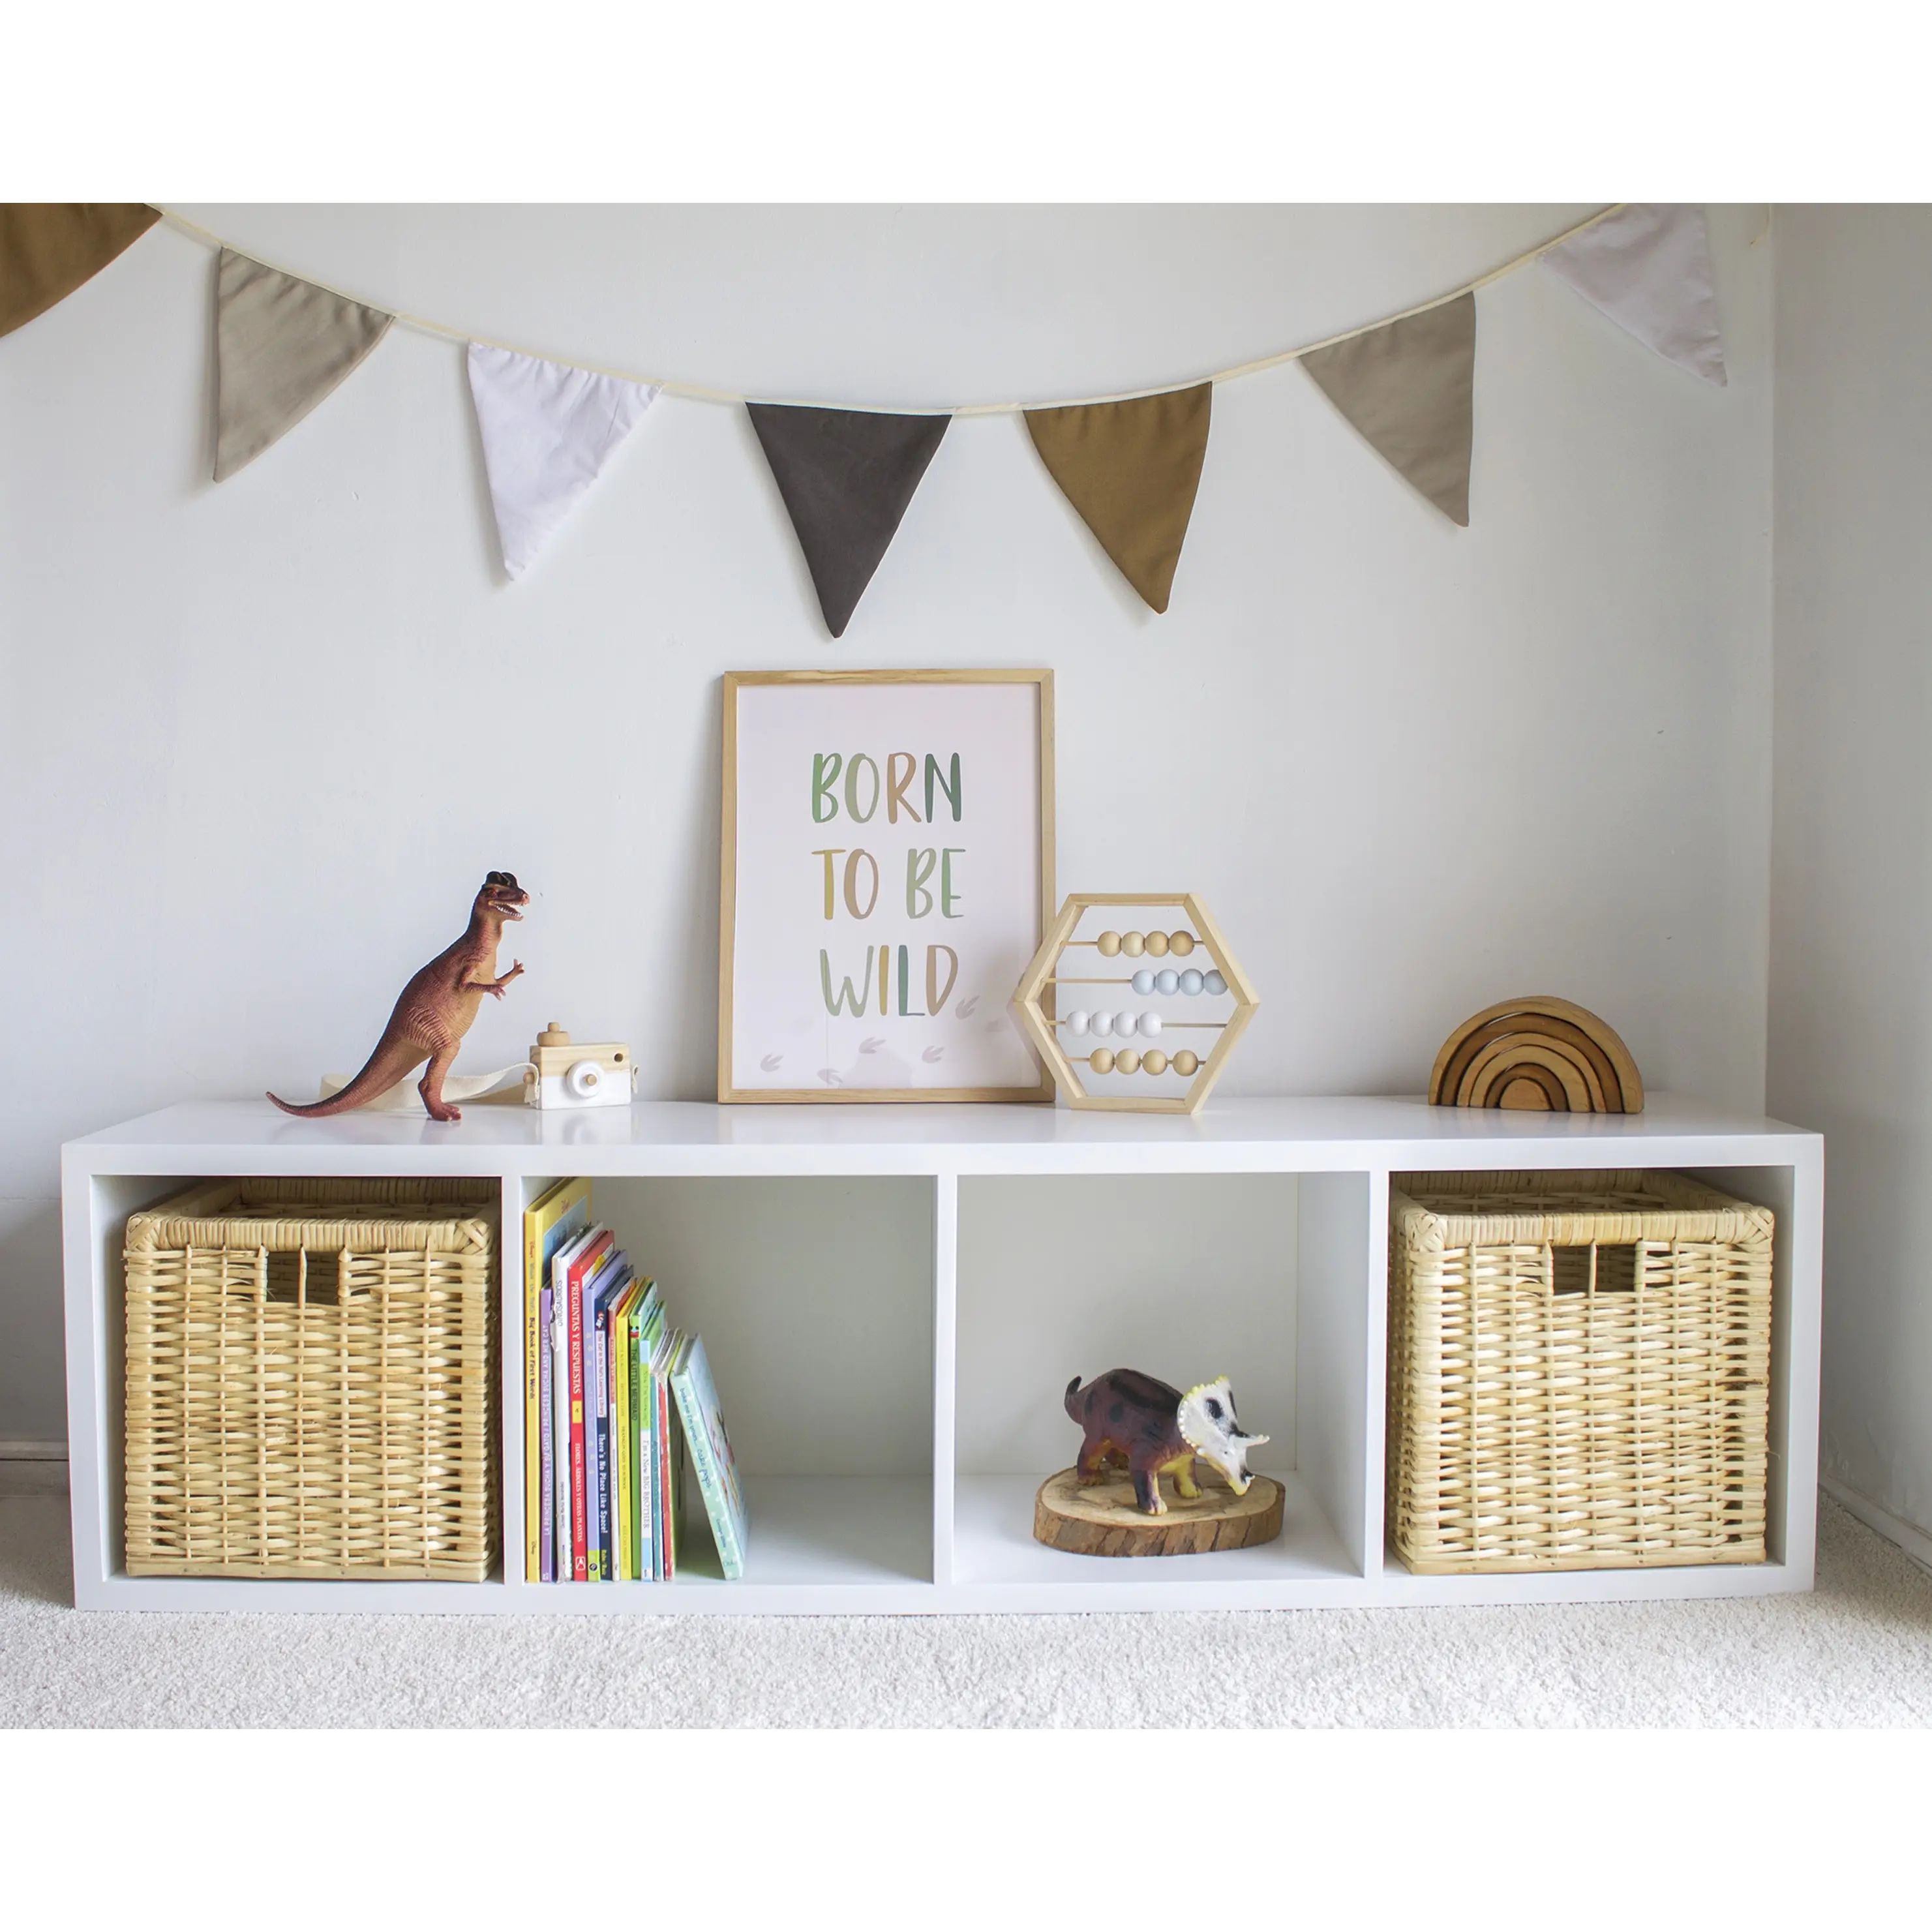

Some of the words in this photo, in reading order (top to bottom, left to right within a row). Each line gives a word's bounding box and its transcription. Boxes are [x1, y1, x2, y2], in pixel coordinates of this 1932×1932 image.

[811, 752, 961, 824] BORN
[811, 848, 879, 920] TO
[906, 847, 966, 920] BE
[820, 944, 958, 1019] WILD
[571, 1280, 580, 1331] PREGUNTAS
[572, 1341, 581, 1394] RESPUESTAS
[599, 1460, 606, 1471] No
[697, 1449, 706, 1467] cake
[544, 1527, 550, 1535] LA
[599, 1510, 608, 1533] Space!
